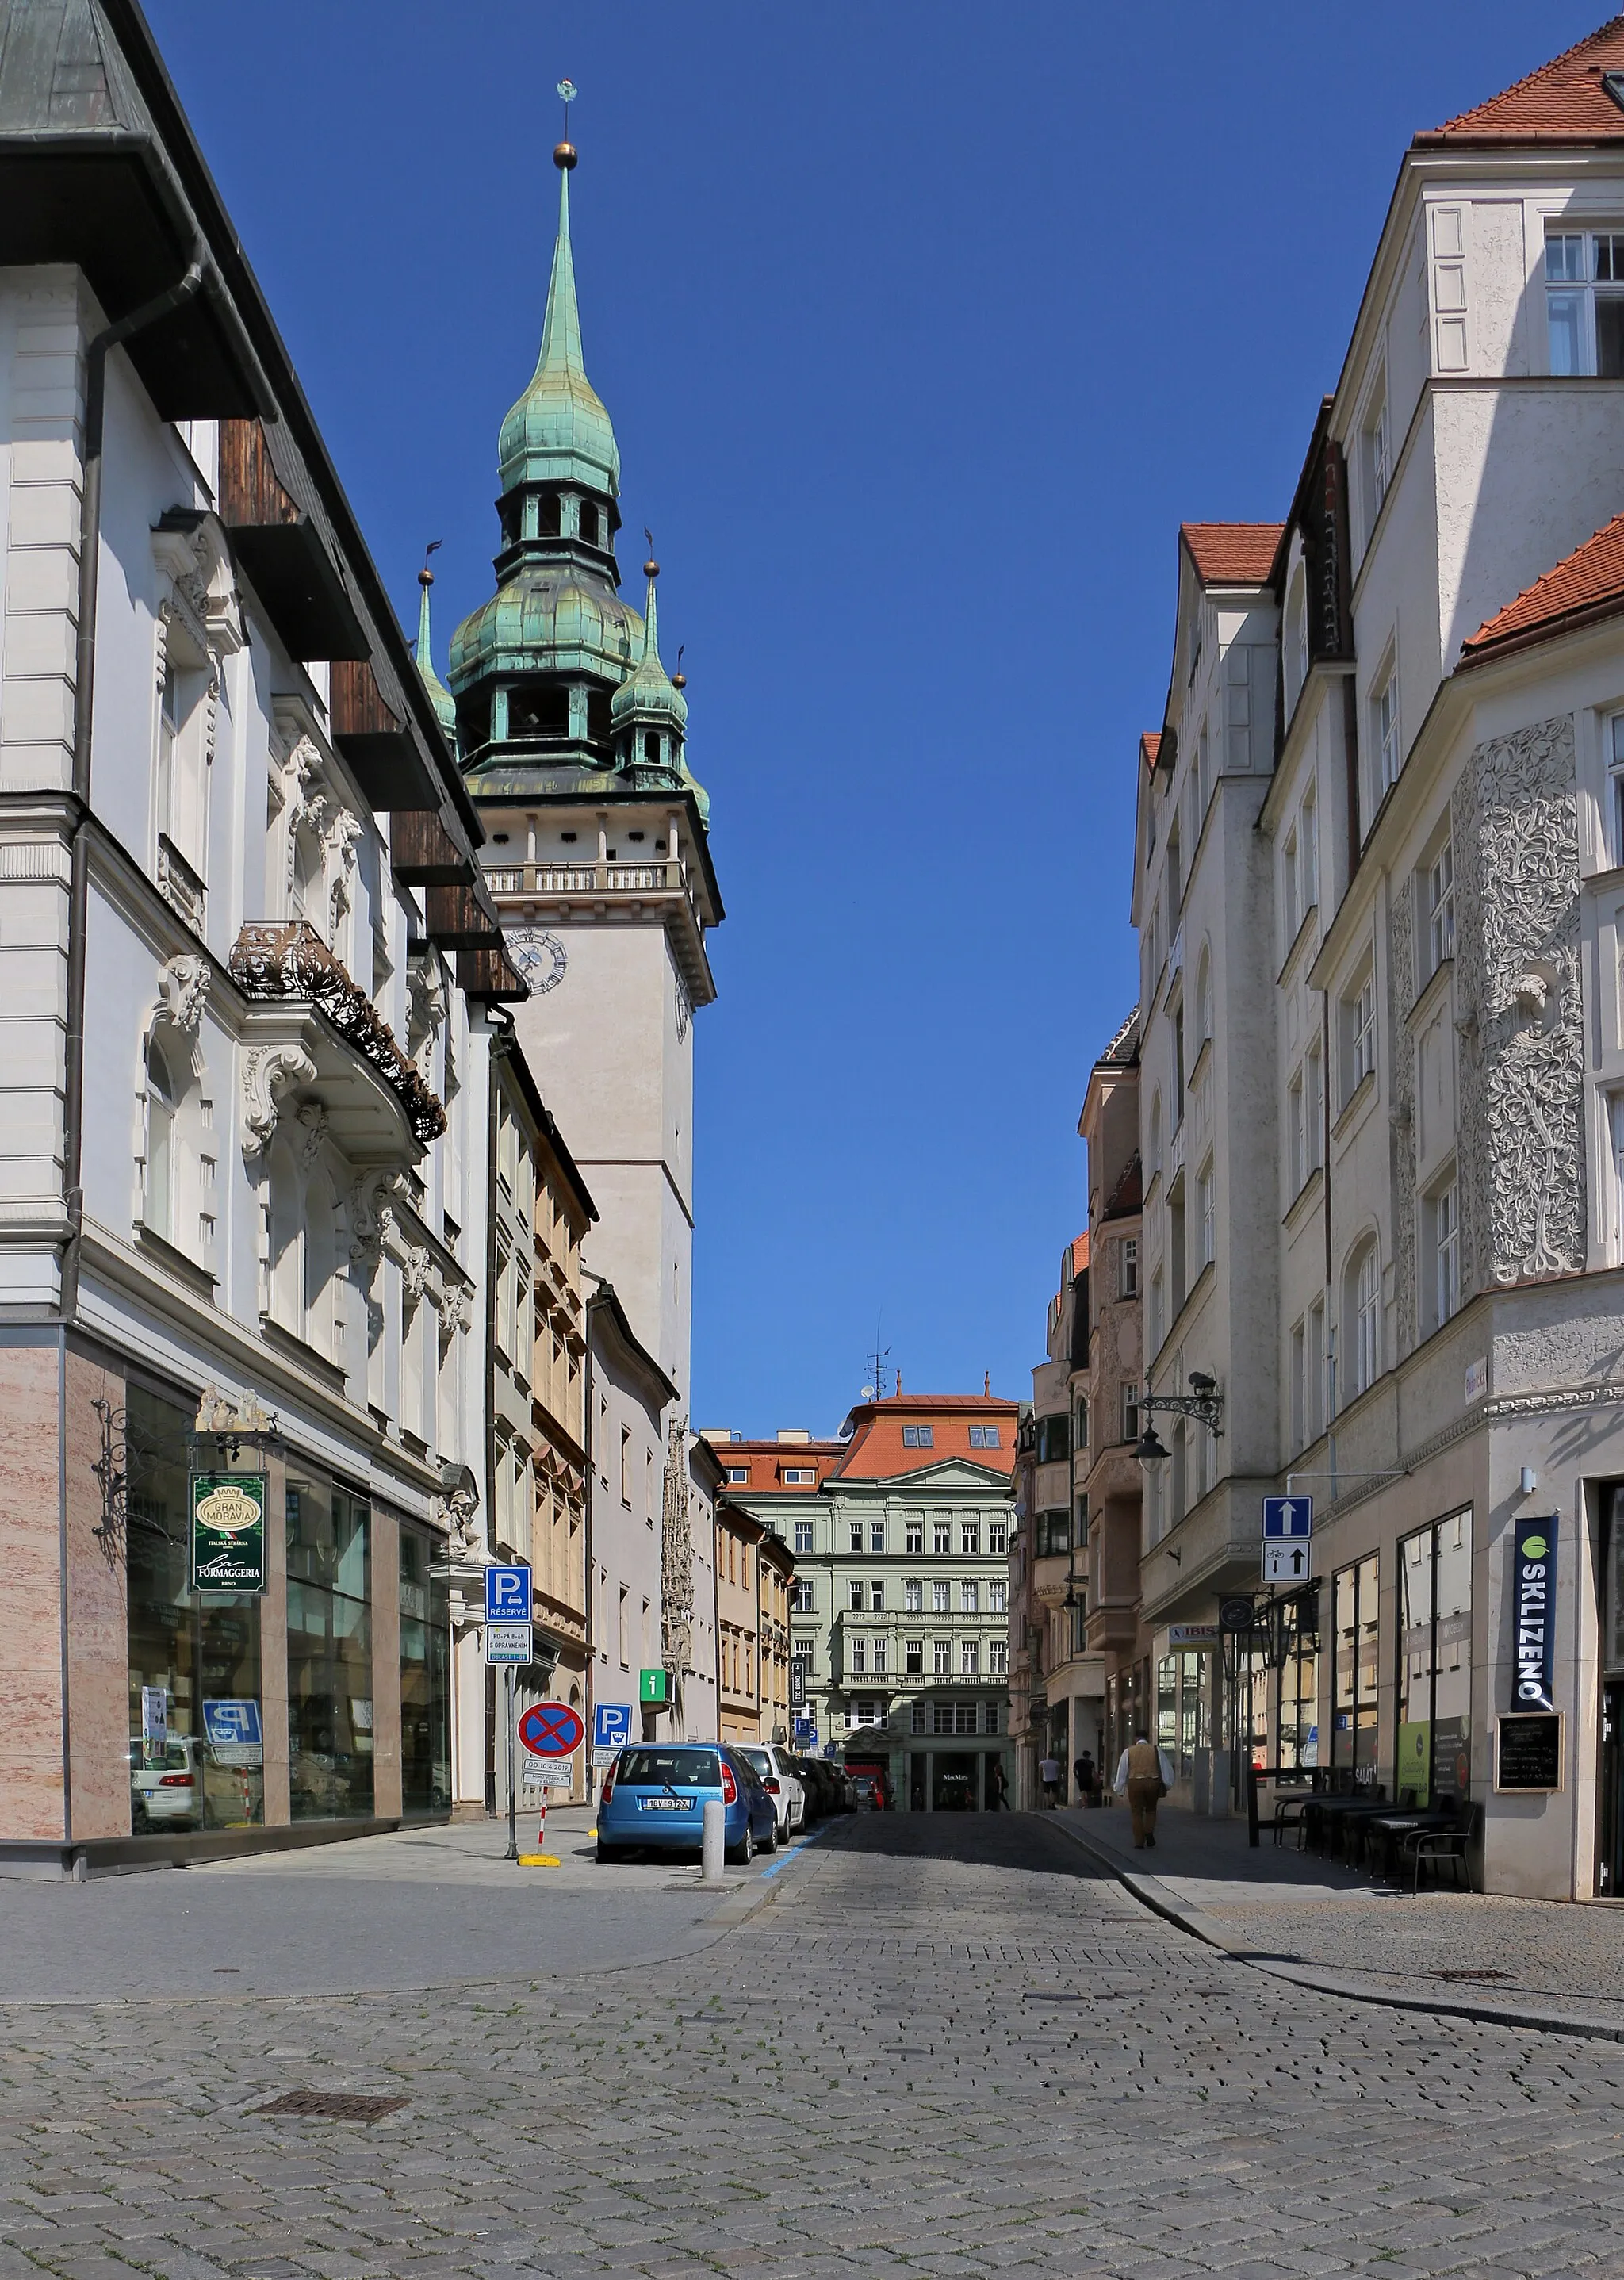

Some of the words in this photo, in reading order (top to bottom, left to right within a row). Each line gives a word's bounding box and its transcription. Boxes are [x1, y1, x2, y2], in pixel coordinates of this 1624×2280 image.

[215, 1503, 242, 1512] GRAN
[198, 1568, 260, 1577] FORMAGGERIA
[495, 1573, 521, 1605] P
[490, 1607, 527, 1615] RÉSERVÉ
[1185, 1627, 1215, 1635] IBIS
[1518, 1563, 1546, 1700] SKLIZENO
[602, 1709, 622, 1734] P
